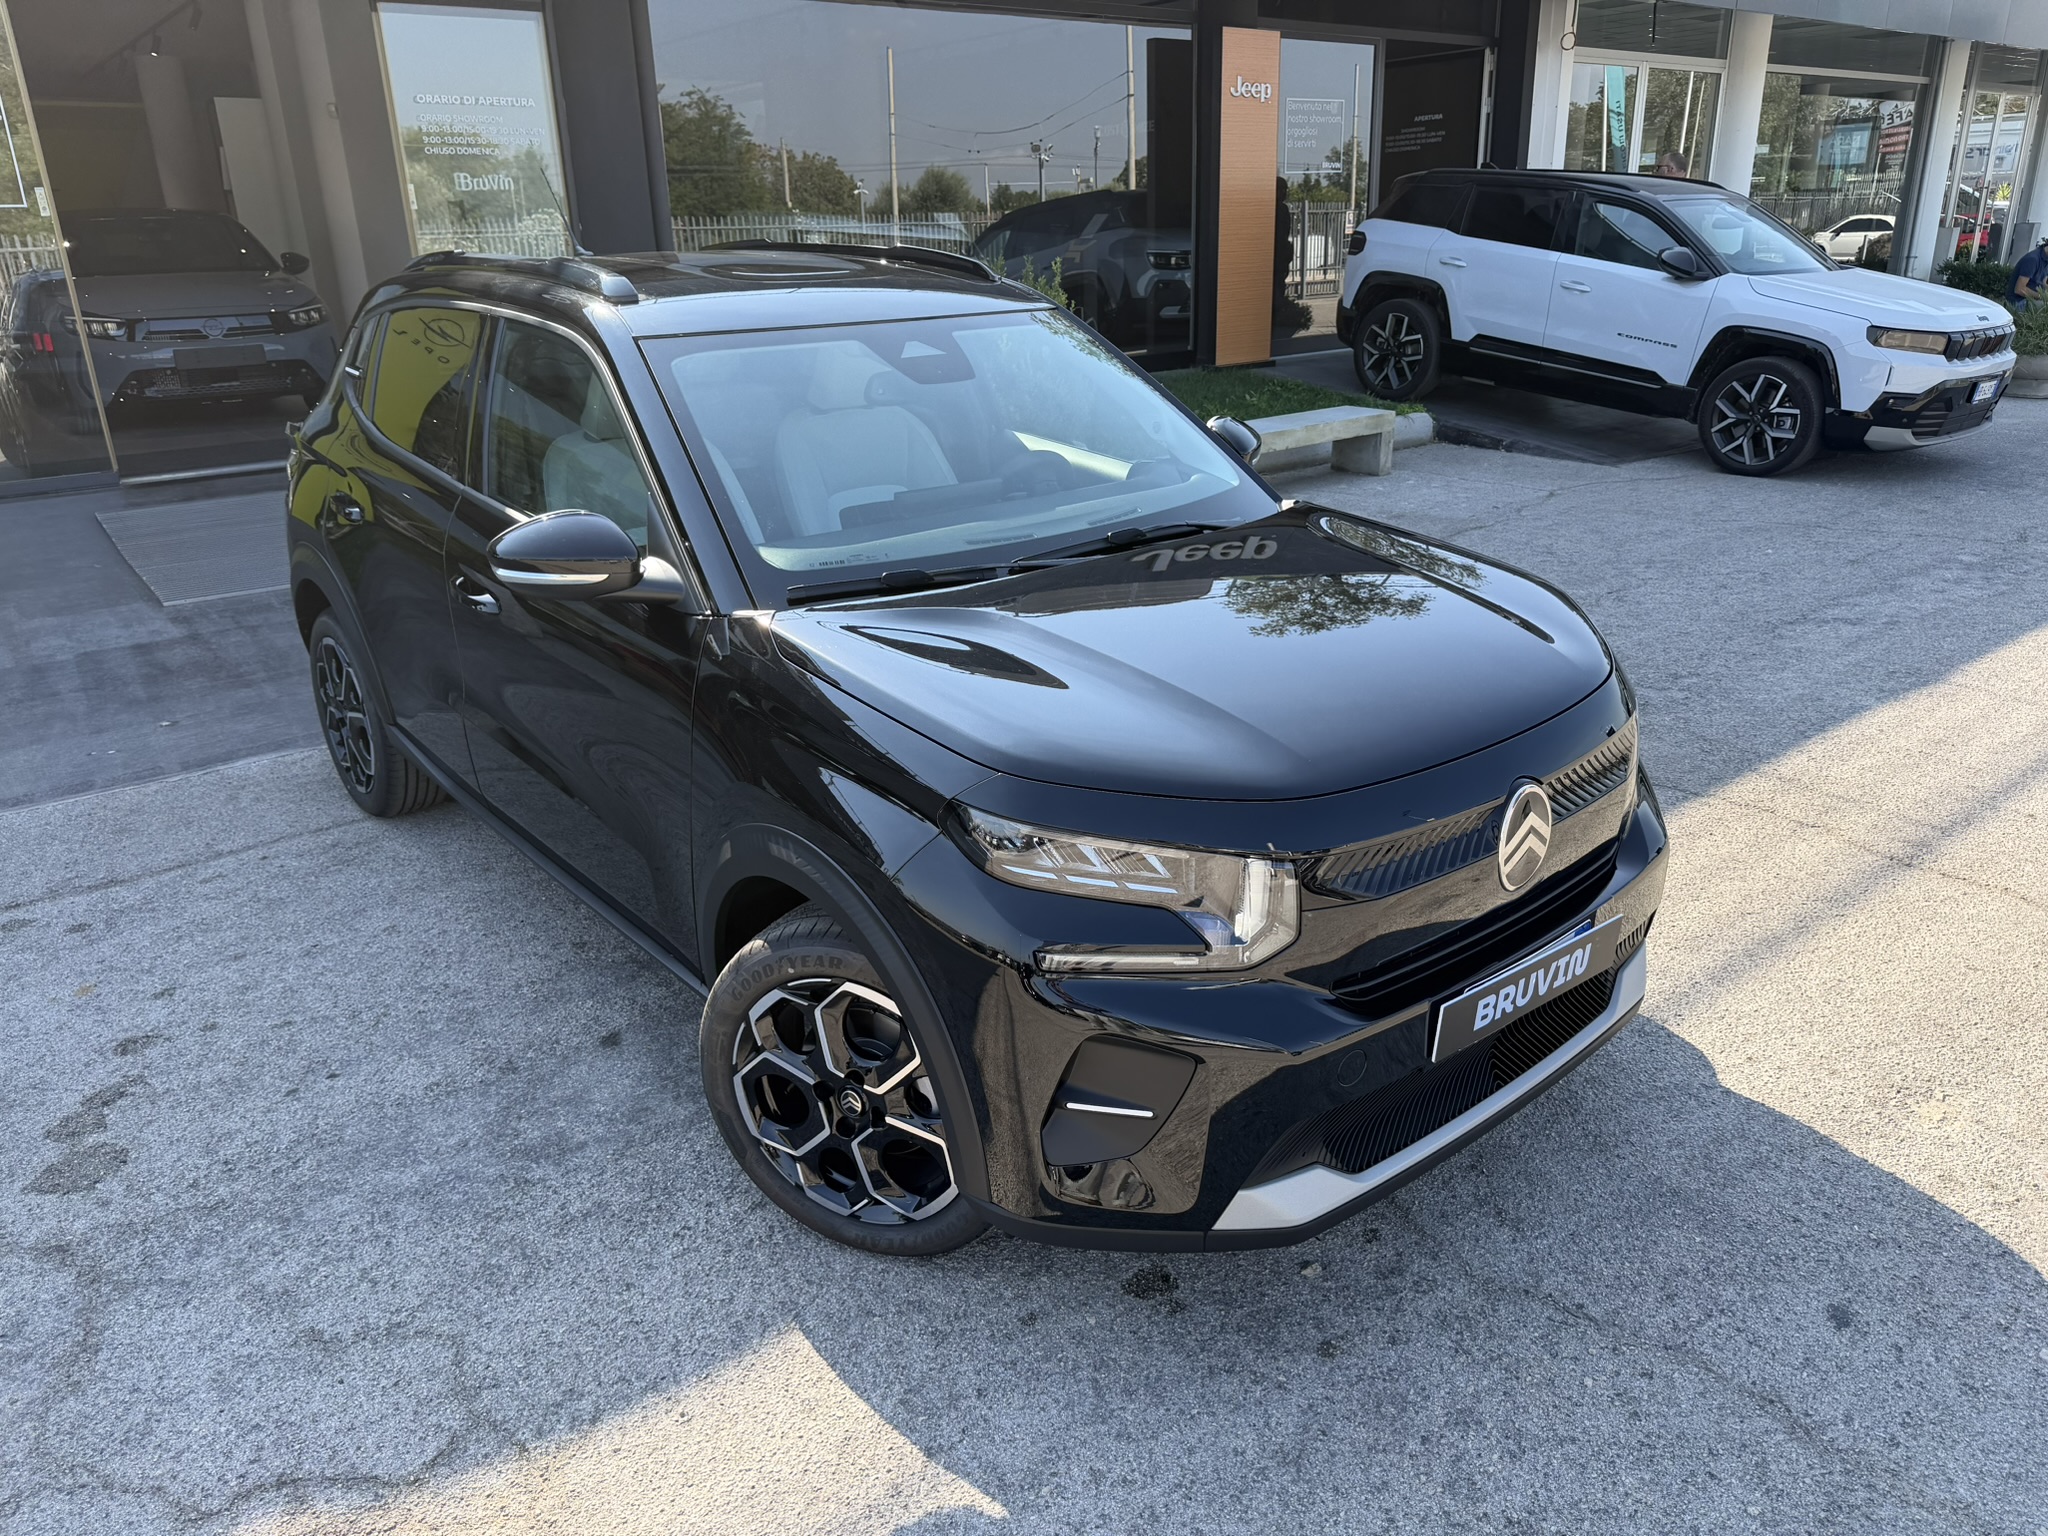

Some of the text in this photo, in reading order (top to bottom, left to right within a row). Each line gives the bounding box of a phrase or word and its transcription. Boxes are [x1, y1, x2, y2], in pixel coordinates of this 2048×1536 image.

[1229, 75, 1272, 103] Jeep
[416, 94, 535, 107] ORARIO DI APERTURA
[419, 113, 503, 123] ORARIO SHOWROOM
[424, 147, 456, 155] CHIUSO
[1617, 332, 1678, 348] COMPASS
[1473, 942, 1592, 1032] BRUVIN
